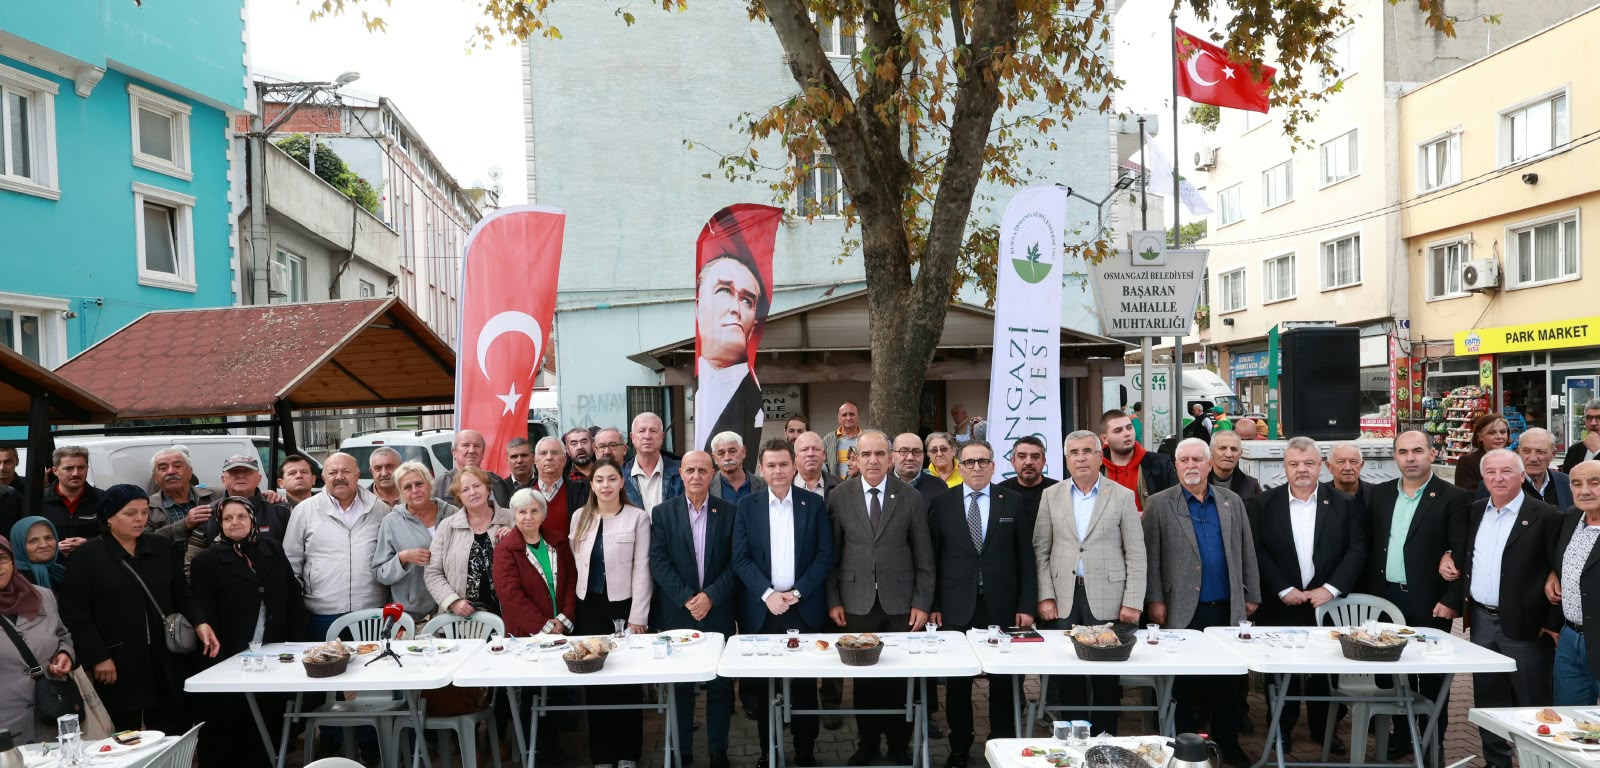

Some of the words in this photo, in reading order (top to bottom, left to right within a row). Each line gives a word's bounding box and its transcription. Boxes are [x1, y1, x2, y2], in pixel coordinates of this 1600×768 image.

[1103, 270, 1149, 280] OSMANGAZİ
[1150, 270, 1194, 280] BELEDİYESİ
[1122, 285, 1176, 299] BAŞARAN
[1120, 301, 1178, 313] MAHALLE
[1112, 315, 1186, 329] MUHTARLIĞI
[1505, 330, 1535, 344] PARK
[1538, 325, 1588, 341] MARKET
[1001, 326, 1029, 480] ANGAZİ
